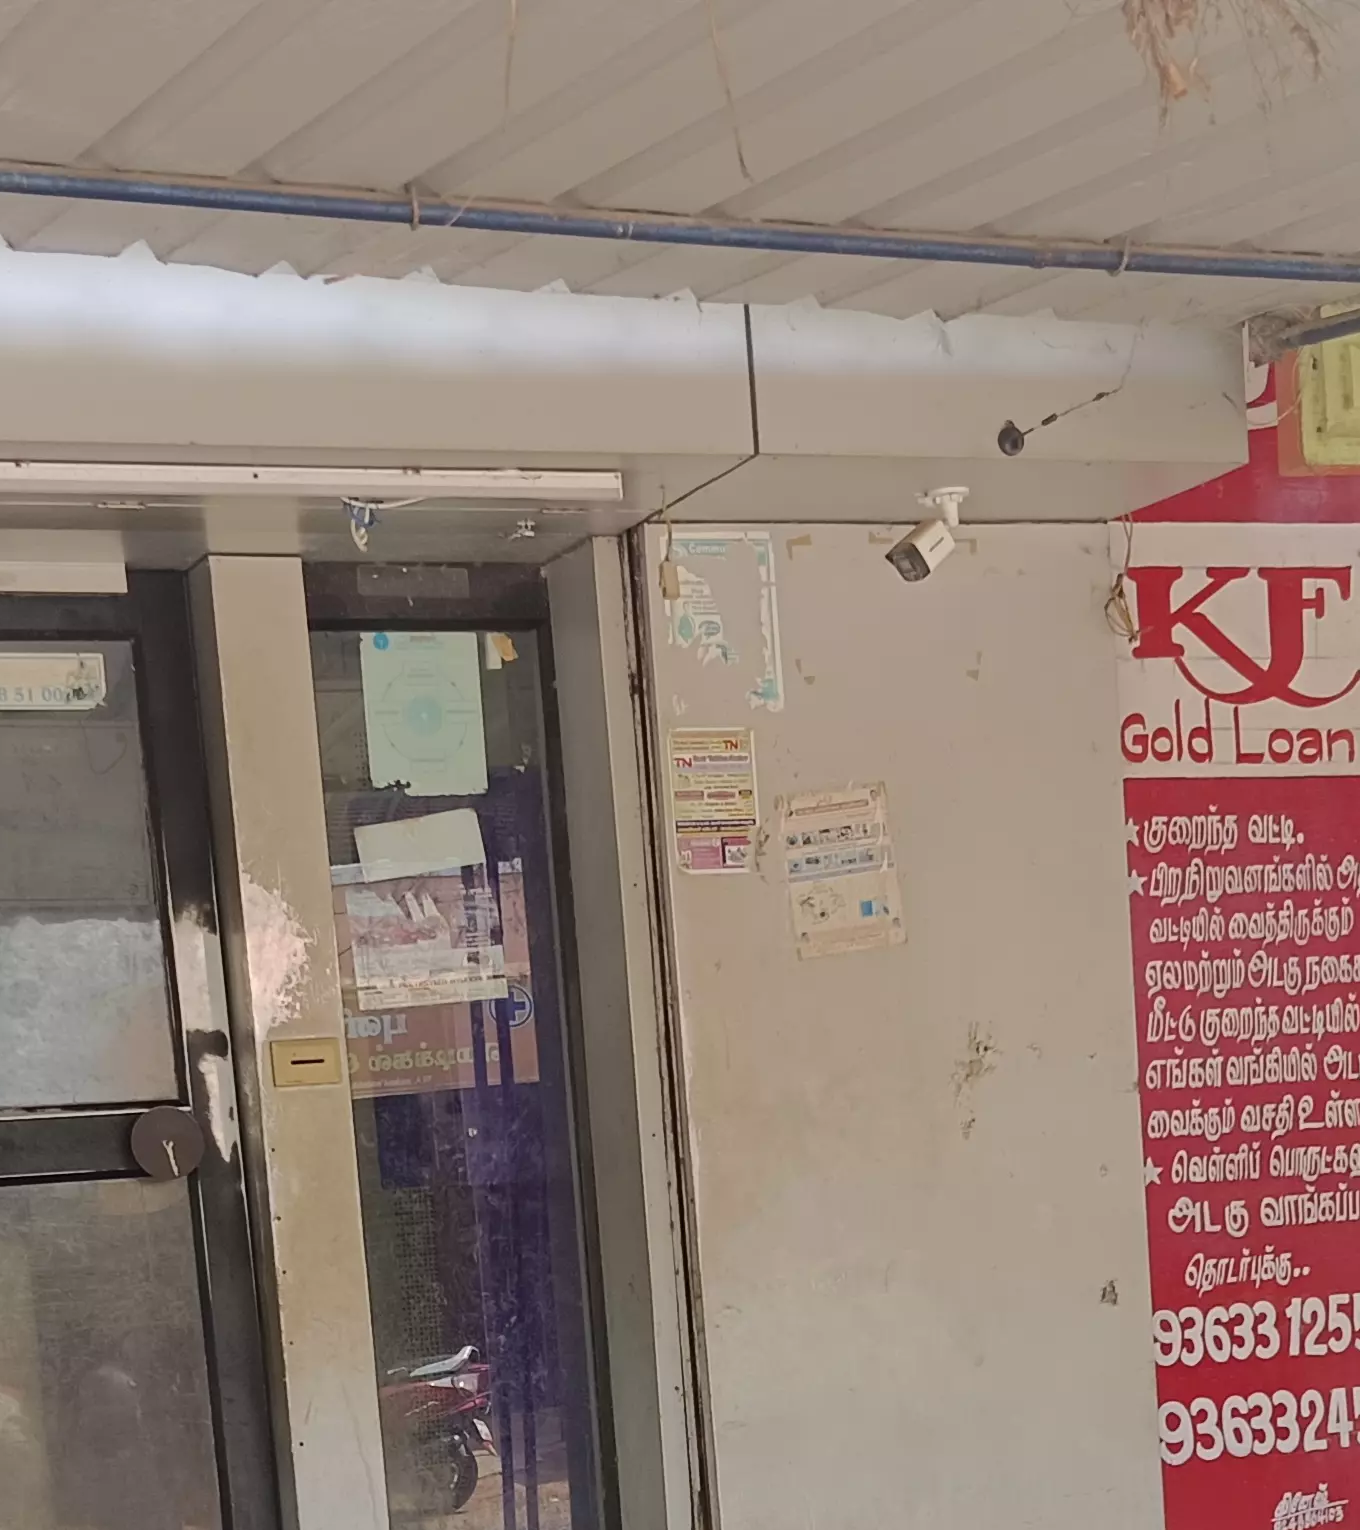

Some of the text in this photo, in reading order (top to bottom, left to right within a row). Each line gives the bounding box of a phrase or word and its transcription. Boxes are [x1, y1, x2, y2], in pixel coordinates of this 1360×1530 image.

[1120, 698, 1356, 765] Gold Loan
[1143, 804, 1305, 855] குறைந்த வட்டி.
[1149, 896, 1354, 951] வட்டியில் வைத்திருக்கும்
[1146, 992, 1360, 1047] மீட்டு குறைந்த வட்டியில்
[1145, 1046, 1223, 1090] எங்கள்
[1226, 1045, 1318, 1086] வங்கியில்
[1147, 1097, 1235, 1142] வைக்கும்
[1239, 1094, 1294, 1141] வசதி
[1171, 1141, 1262, 1184] வெள்ளிப்
[1167, 1196, 1249, 1238] அடகு
